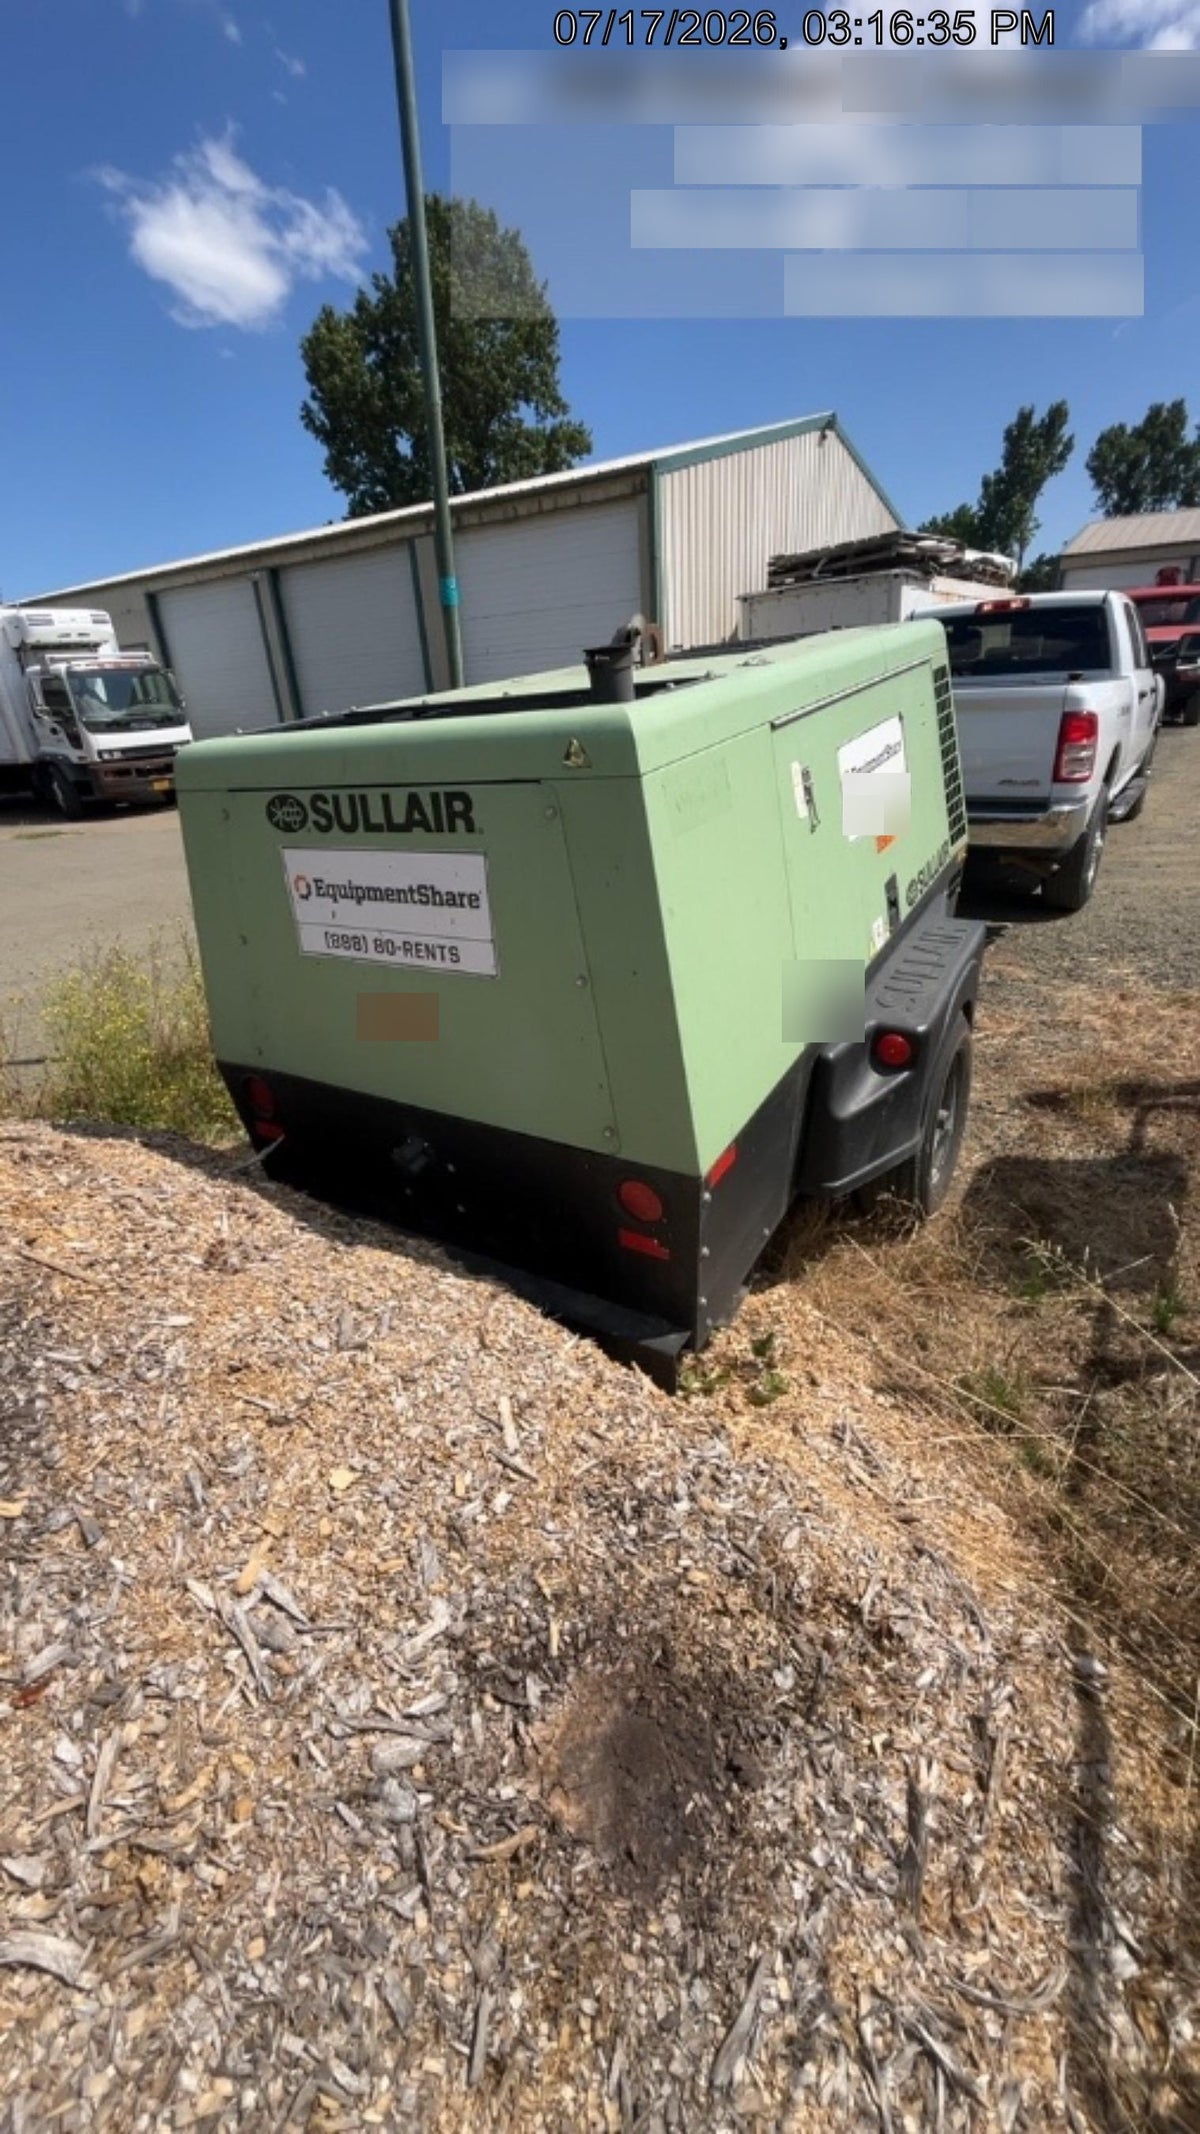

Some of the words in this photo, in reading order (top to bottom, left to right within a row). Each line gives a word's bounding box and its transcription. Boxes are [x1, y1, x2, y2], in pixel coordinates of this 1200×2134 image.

[309, 791, 476, 833] SULLAIR
[313, 878, 481, 909] EquipmentShare
[324, 931, 369, 954] (888)
[374, 938, 461, 964] 80-RENTS
